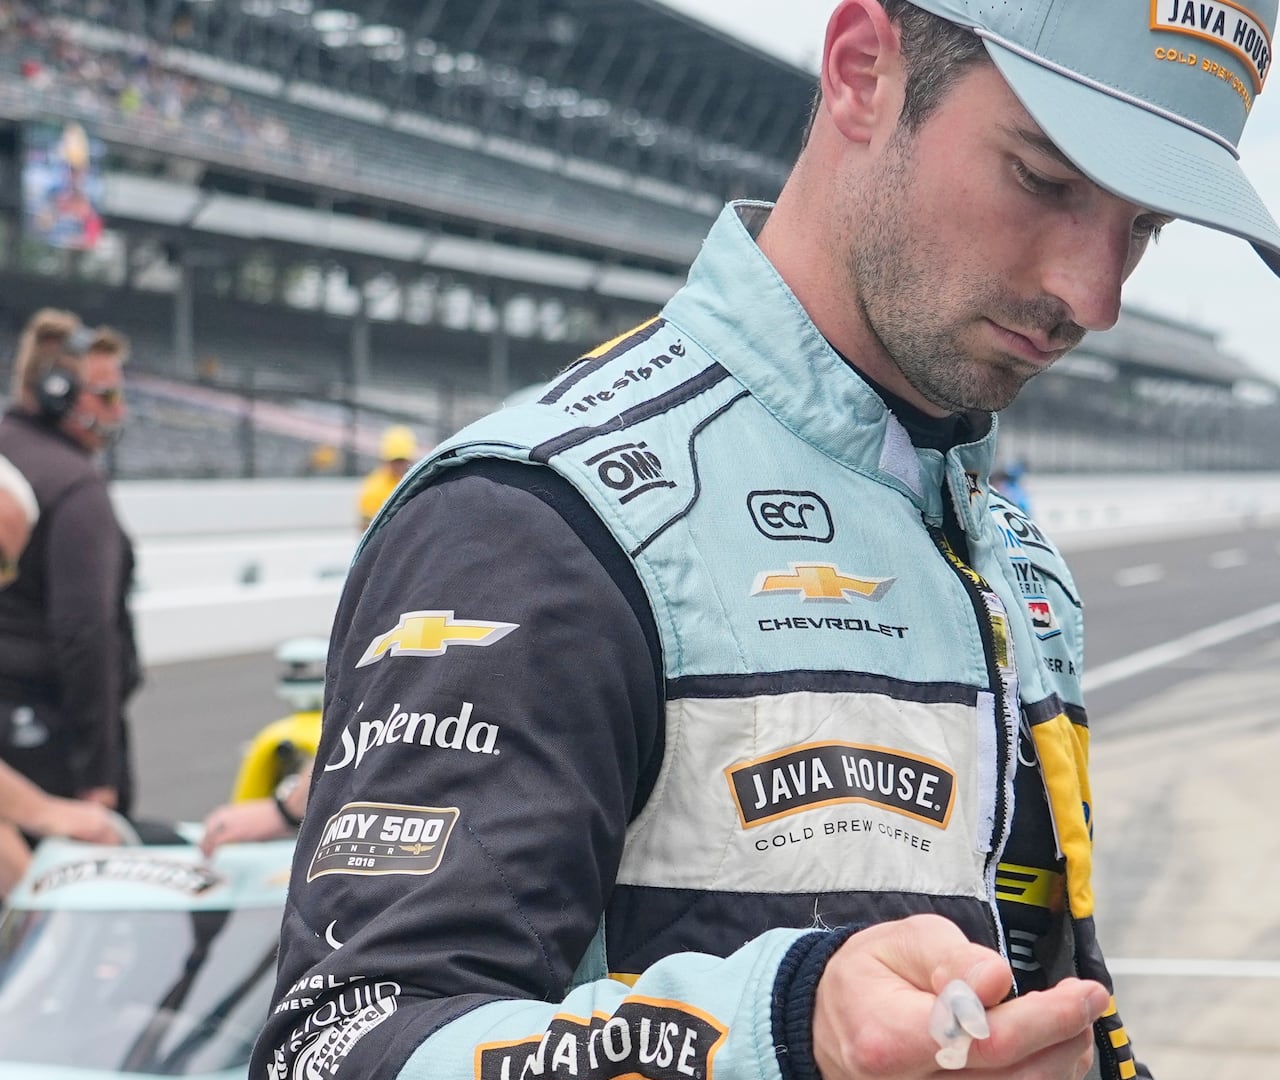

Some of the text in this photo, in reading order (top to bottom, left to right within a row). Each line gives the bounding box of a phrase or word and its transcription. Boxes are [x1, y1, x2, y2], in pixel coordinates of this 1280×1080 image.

[1168, 0, 1225, 36] JAVA
[1154, 47, 1198, 66] COLD
[1202, 58, 1232, 84] BREW
[597, 450, 662, 491] OMP
[758, 617, 908, 639] CHEVROLET
[324, 701, 501, 772] Splenda
[751, 755, 941, 811] JAVA HOUSE
[380, 816, 444, 843] 500
[755, 819, 932, 852] COLD BREW COFFEE
[347, 857, 376, 867] 2016
